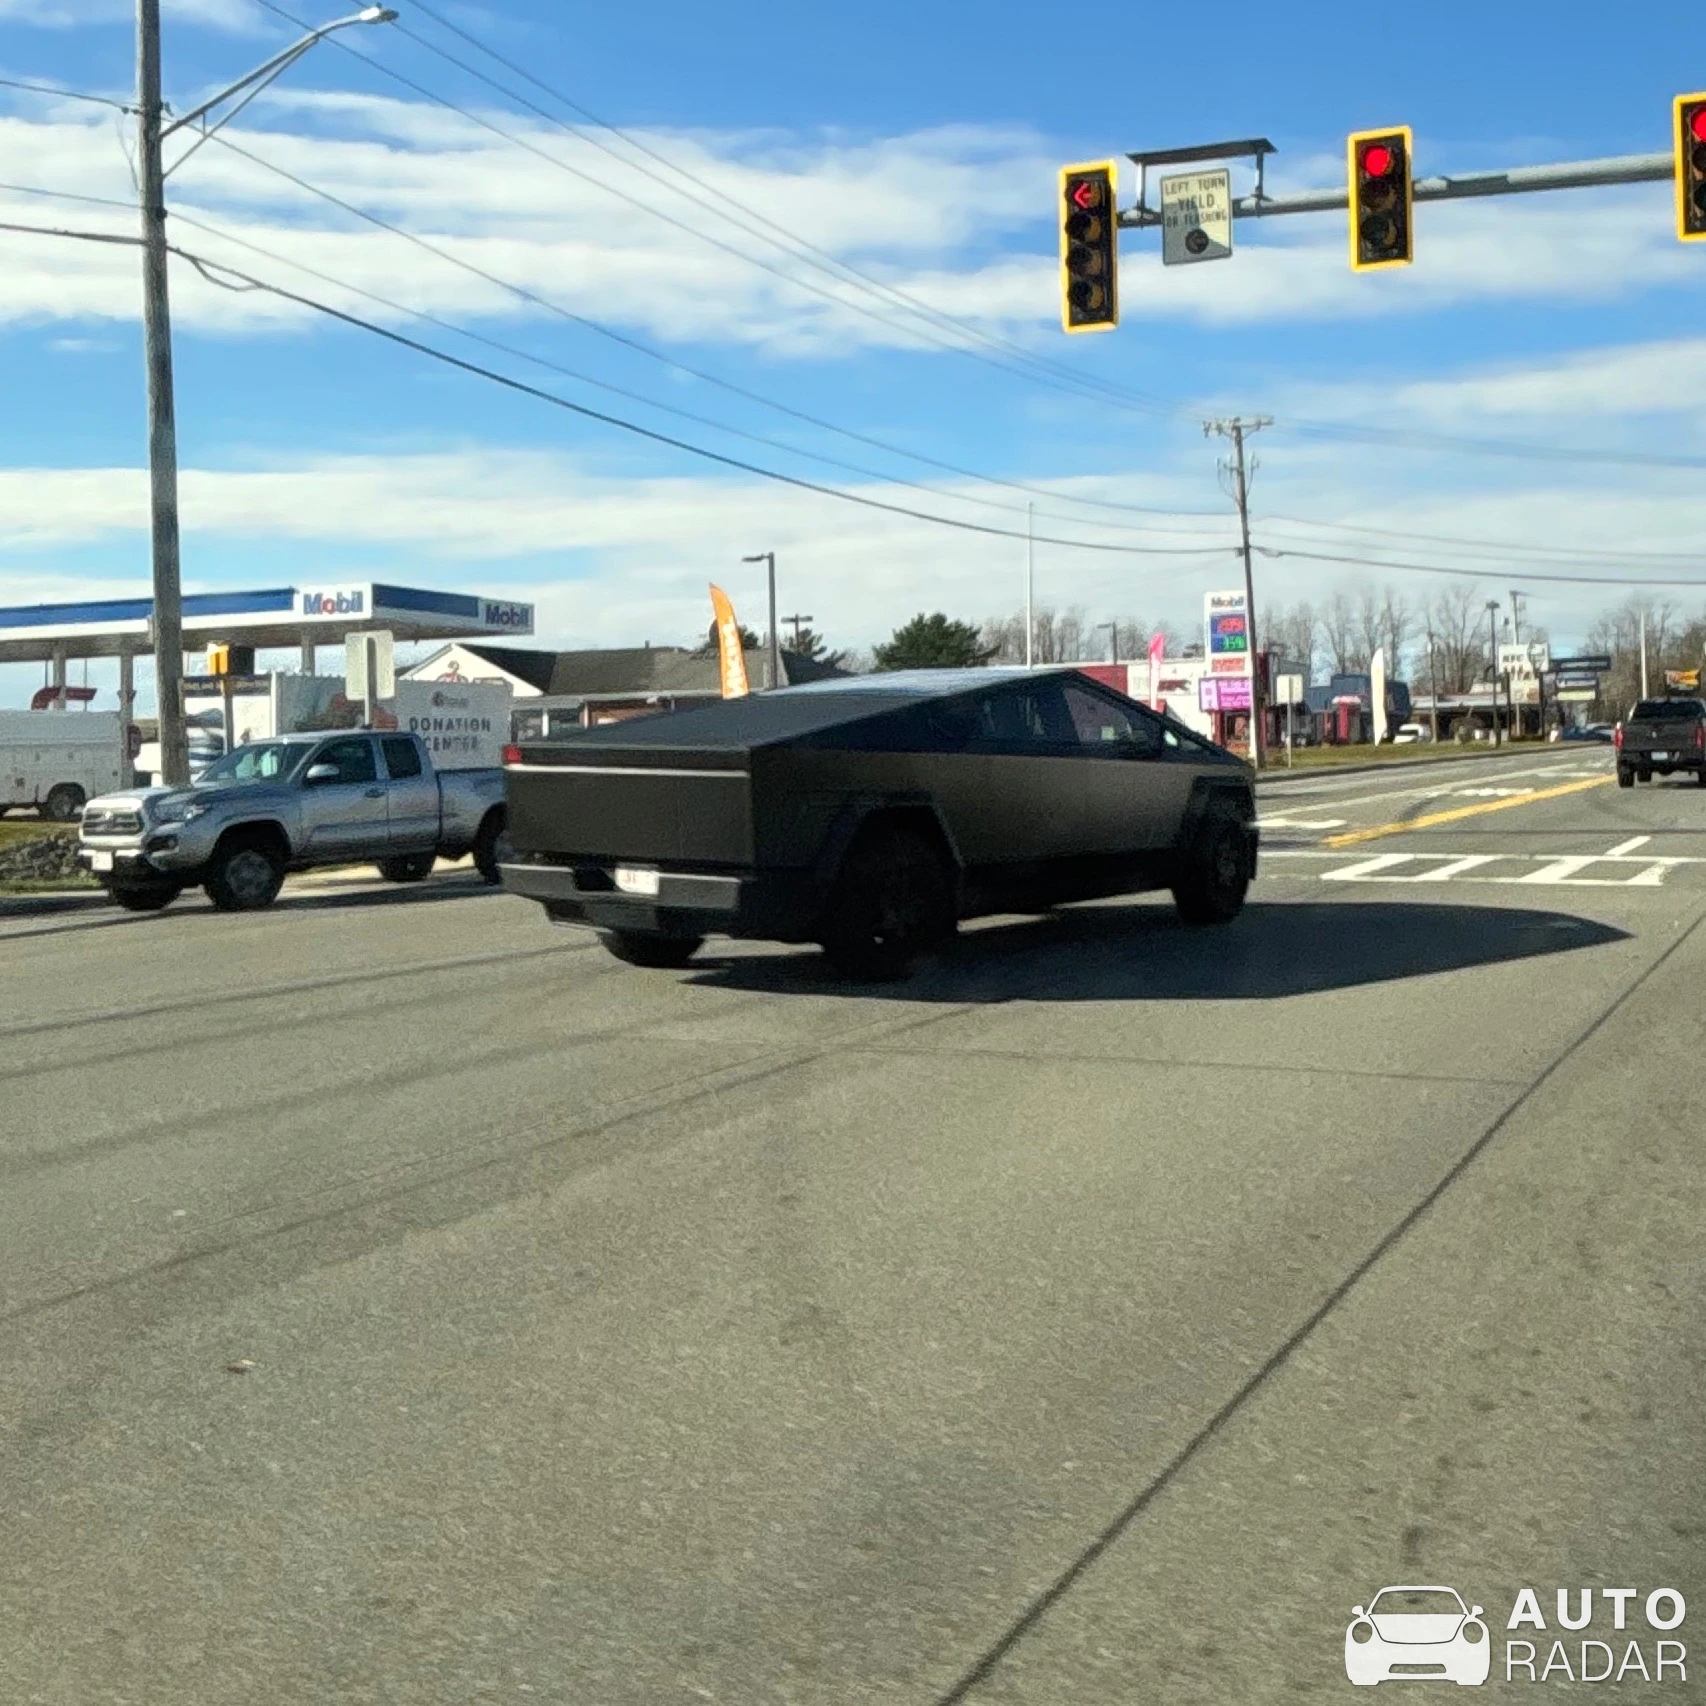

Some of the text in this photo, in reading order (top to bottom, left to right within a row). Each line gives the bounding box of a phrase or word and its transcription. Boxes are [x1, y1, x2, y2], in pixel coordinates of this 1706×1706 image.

[1165, 177, 1225, 196] LEFT TURN
[1178, 193, 1215, 211] YIELD
[303, 591, 363, 615] Mobil
[486, 603, 529, 625] Mobil
[409, 717, 491, 733] DONATION
